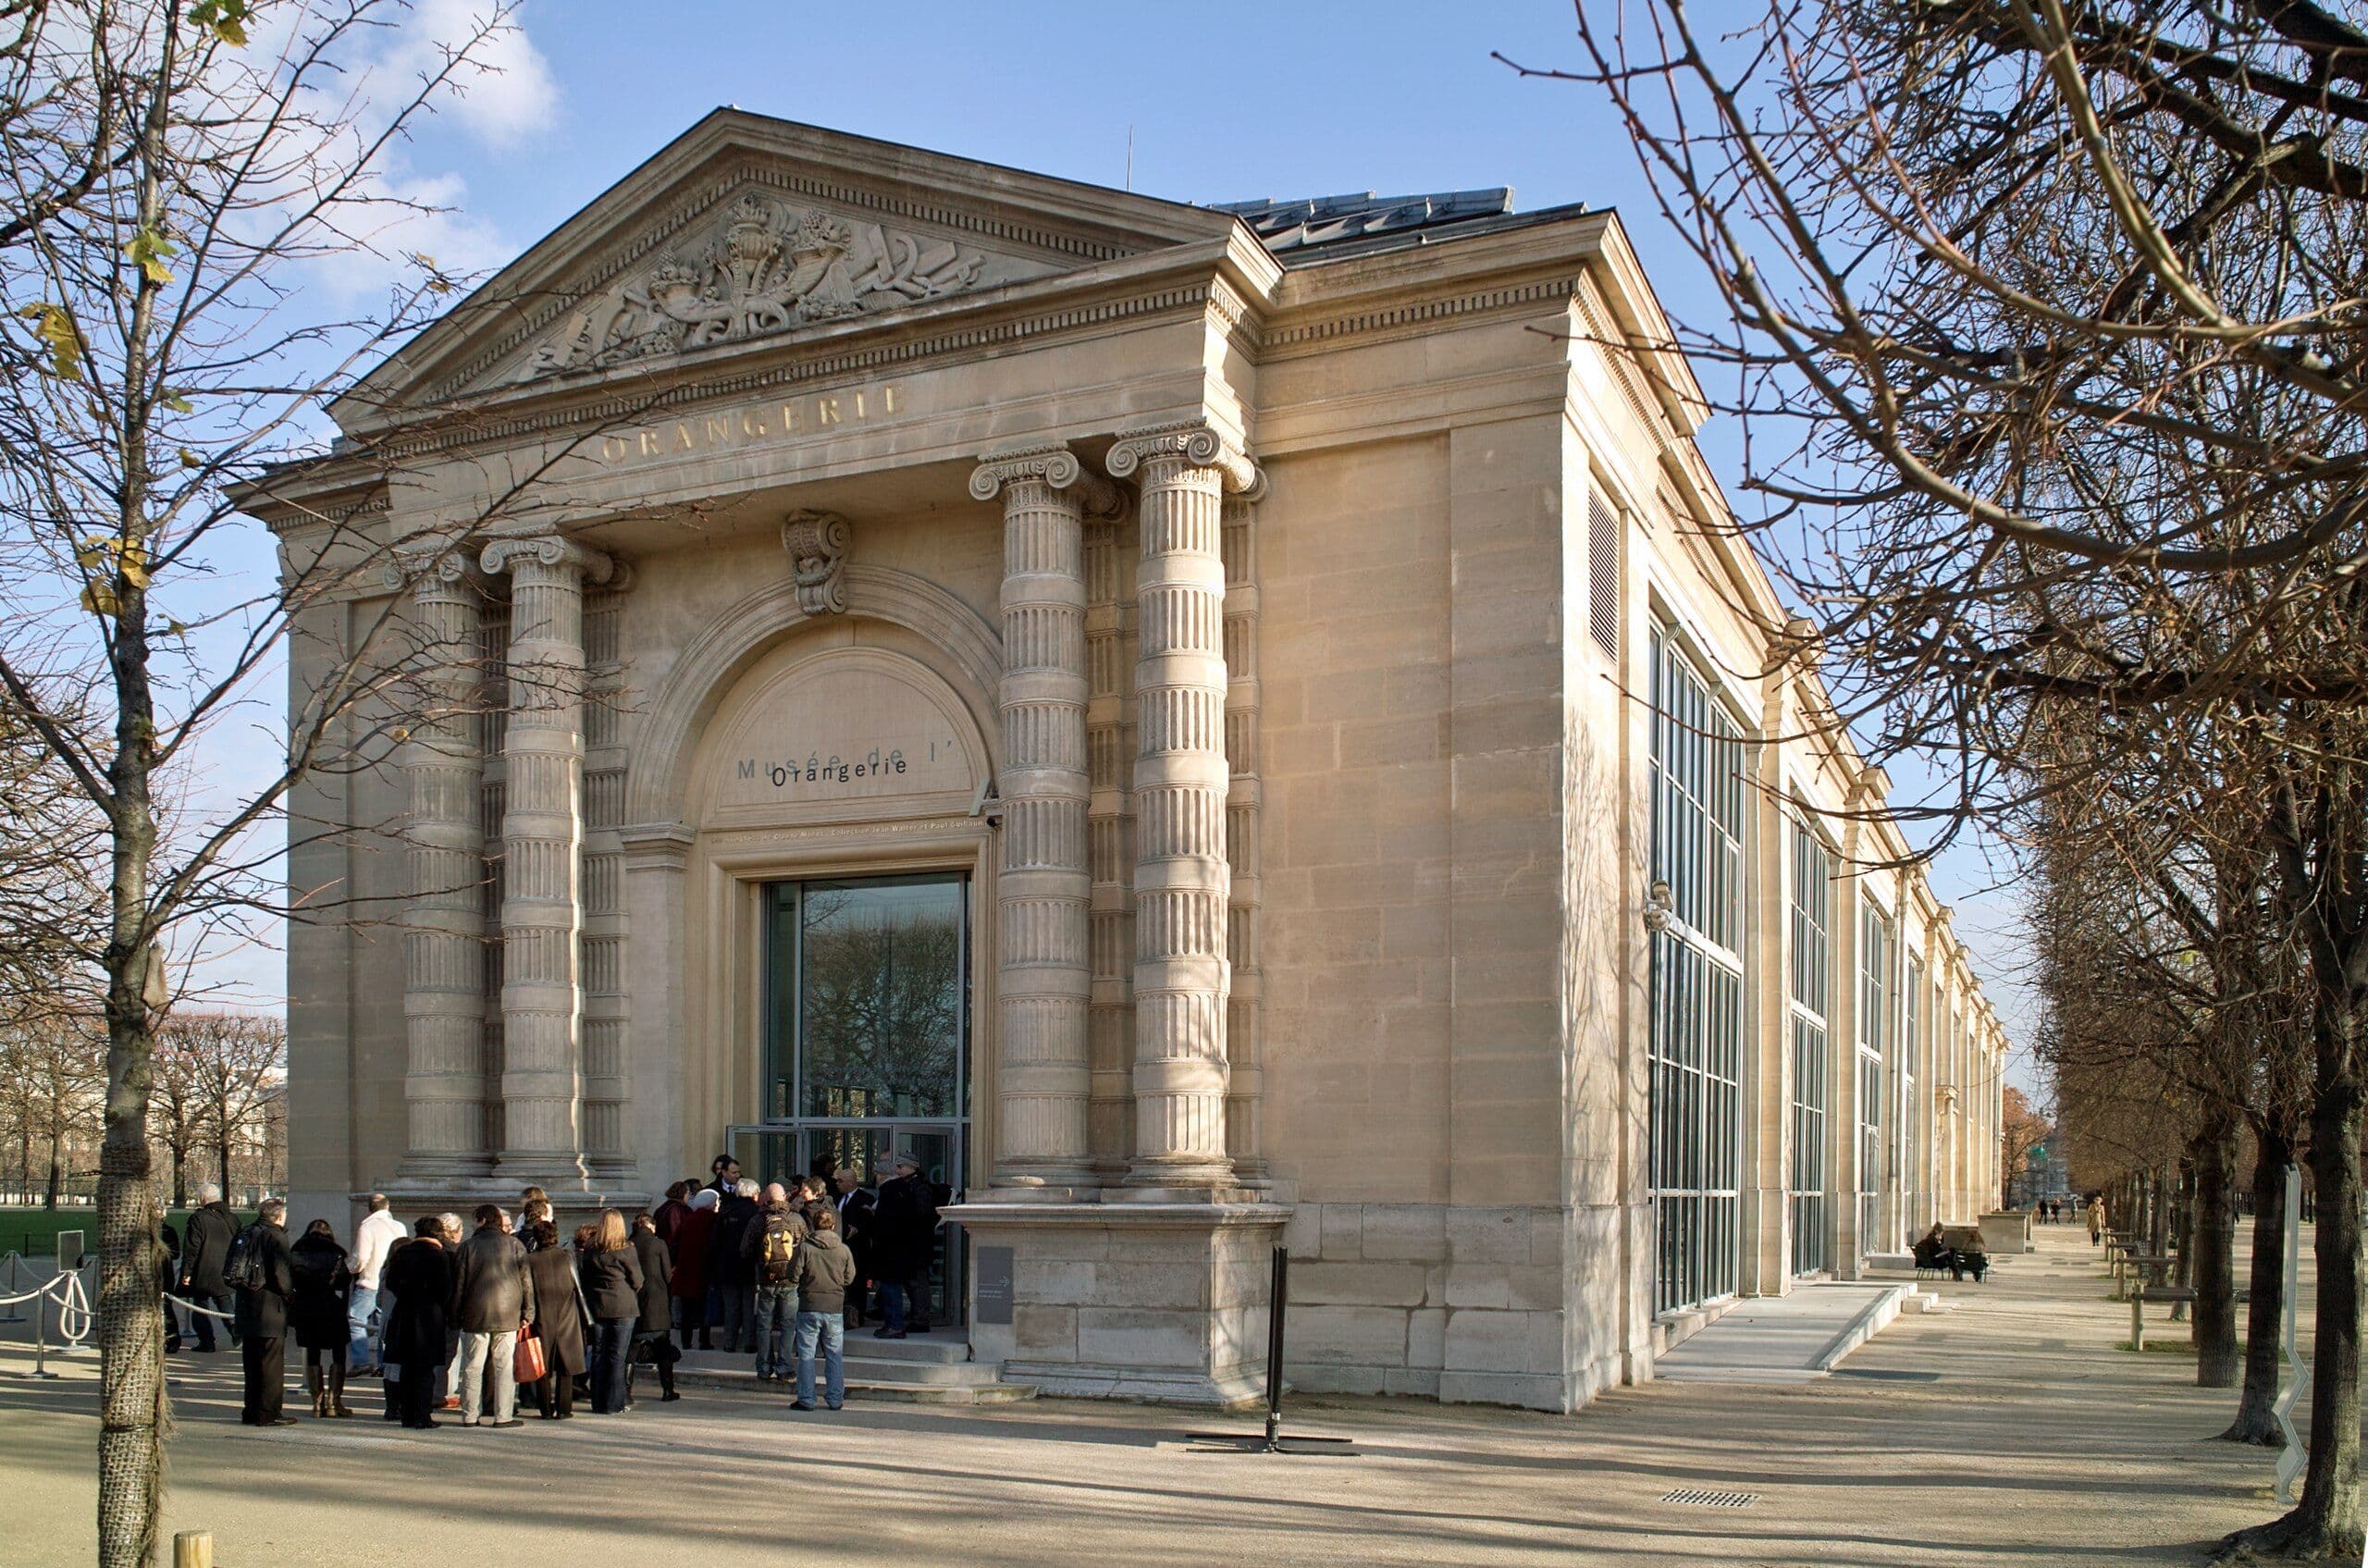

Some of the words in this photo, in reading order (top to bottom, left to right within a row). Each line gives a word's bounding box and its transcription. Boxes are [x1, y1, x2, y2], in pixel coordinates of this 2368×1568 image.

[603, 384, 904, 463] ORANGERIE
[738, 751, 841, 779] Musée
[868, 748, 903, 767] de
[772, 759, 906, 786] Orangerie
